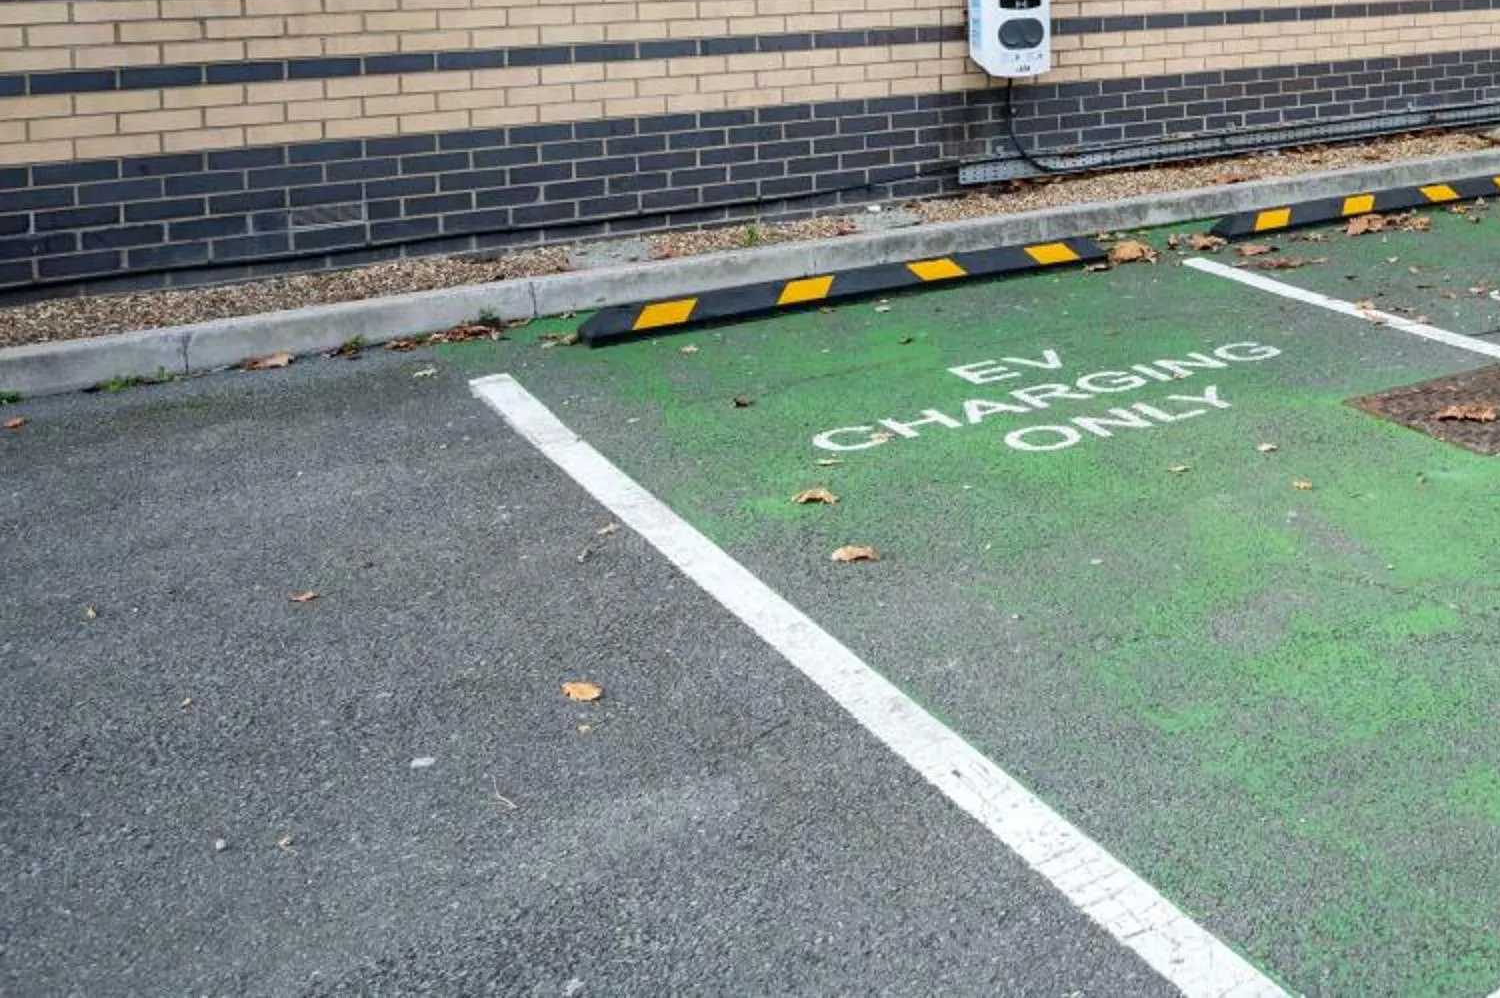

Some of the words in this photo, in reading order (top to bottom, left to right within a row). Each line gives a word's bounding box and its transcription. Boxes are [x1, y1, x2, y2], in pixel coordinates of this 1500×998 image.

[811, 340, 1282, 453] CHARGING
[947, 348, 1064, 386] EV
[1003, 384, 1233, 452] ONLY
